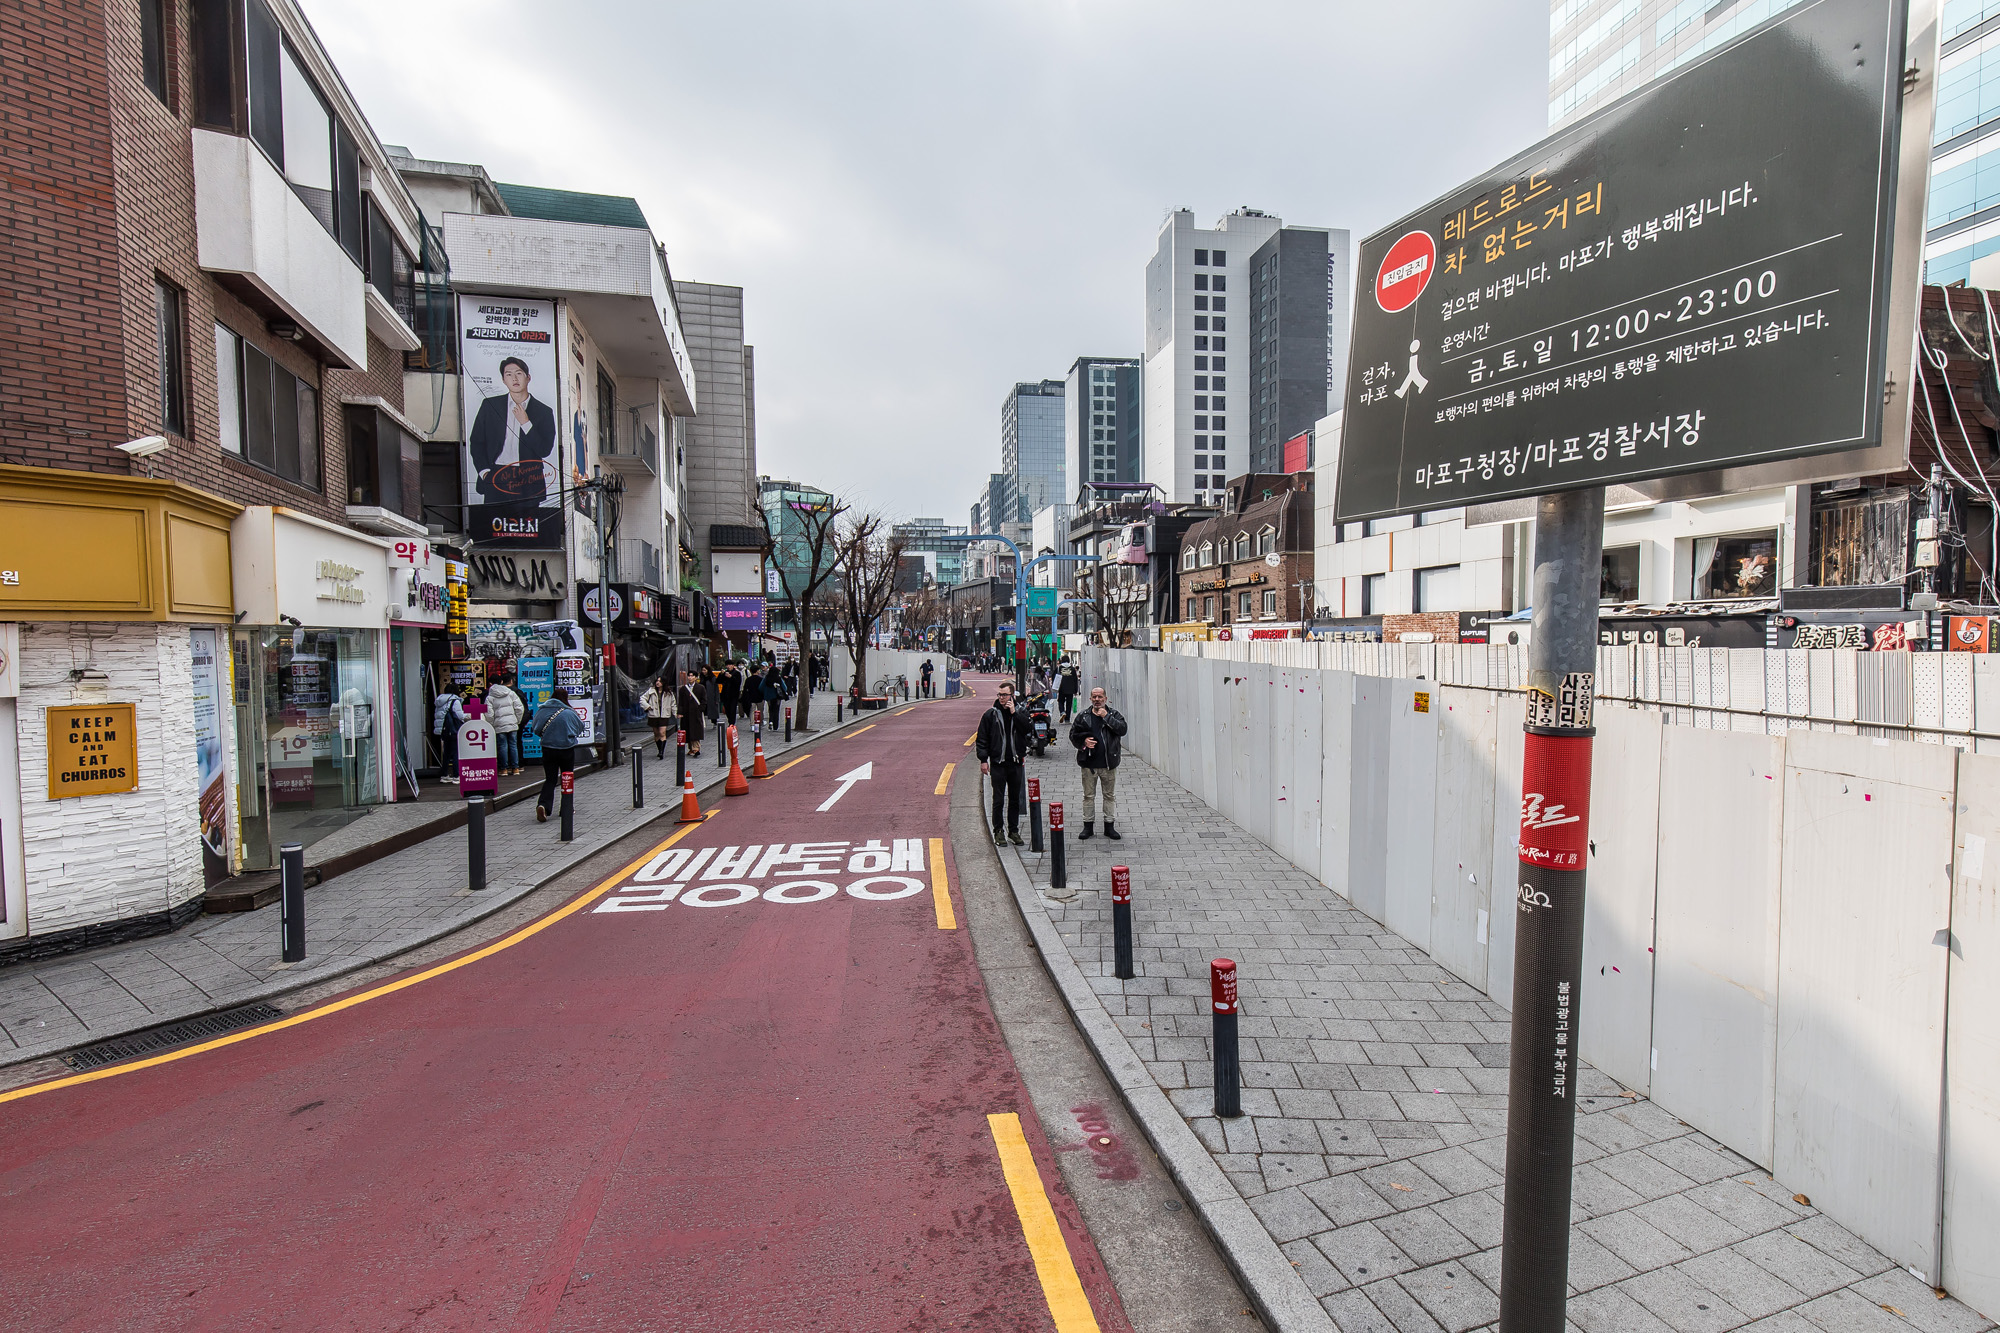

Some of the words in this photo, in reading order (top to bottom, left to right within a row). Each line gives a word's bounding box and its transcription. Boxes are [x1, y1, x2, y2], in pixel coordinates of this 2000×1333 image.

[1444, 168, 1552, 240] 레드로드
[1444, 247, 1467, 275] 차
[1483, 182, 1603, 264] 없는거리
[1441, 288, 1480, 321] 걸으면
[1486, 261, 1551, 301] 바뀝니다.
[1559, 235, 1614, 273] 마포가
[1621, 181, 1758, 251] 행복해집니다.
[1327, 252, 1335, 311] Mercure
[1387, 257, 1425, 285] 진입금지
[478, 305, 520, 316] 세대교체를
[522, 308, 539, 318] 위한
[485, 315, 511, 326] 완벽한
[513, 318, 530, 327] 치킨
[1571, 270, 1777, 353] 12:00~23:00
[472, 327, 498, 338] 치킨의
[500, 330, 519, 340] No.1
[521, 331, 547, 341] 아라치
[1441, 322, 1491, 353] 운영시간
[477, 342, 513, 350] Generational
[482, 349, 493, 357] Soy
[1362, 361, 1396, 386] 걷자,
[1434, 400, 1478, 424] 보행자의
[1481, 390, 1517, 413] 편의를
[1521, 377, 1560, 402] 위하여
[1564, 365, 1606, 390] 차량의
[1612, 352, 1660, 380] 통행을
[1665, 333, 1737, 364] 제한하고
[1744, 308, 1830, 348] 있습니다.
[1360, 385, 1388, 406] 마포
[493, 517, 539, 532] 아라치
[394, 541, 417, 563] 약
[587, 596, 619, 608] 아치
[1792, 625, 1866, 649] 居酒屋
[556, 659, 584, 669] 사격장
[71, 716, 114, 729] KEEP
[69, 731, 117, 744] CALM
[82, 744, 104, 752] AND
[465, 729, 489, 751] 약
[78, 755, 109, 767] EAT
[61, 767, 126, 783] CHURROS
[461, 769, 495, 777] 어울림약국
[1528, 847, 1549, 861] Road
[592, 838, 926, 913] 일방통행
[1552, 981, 1571, 1045] 불법광고물
[1552, 1047, 1567, 1098] 부착금지
